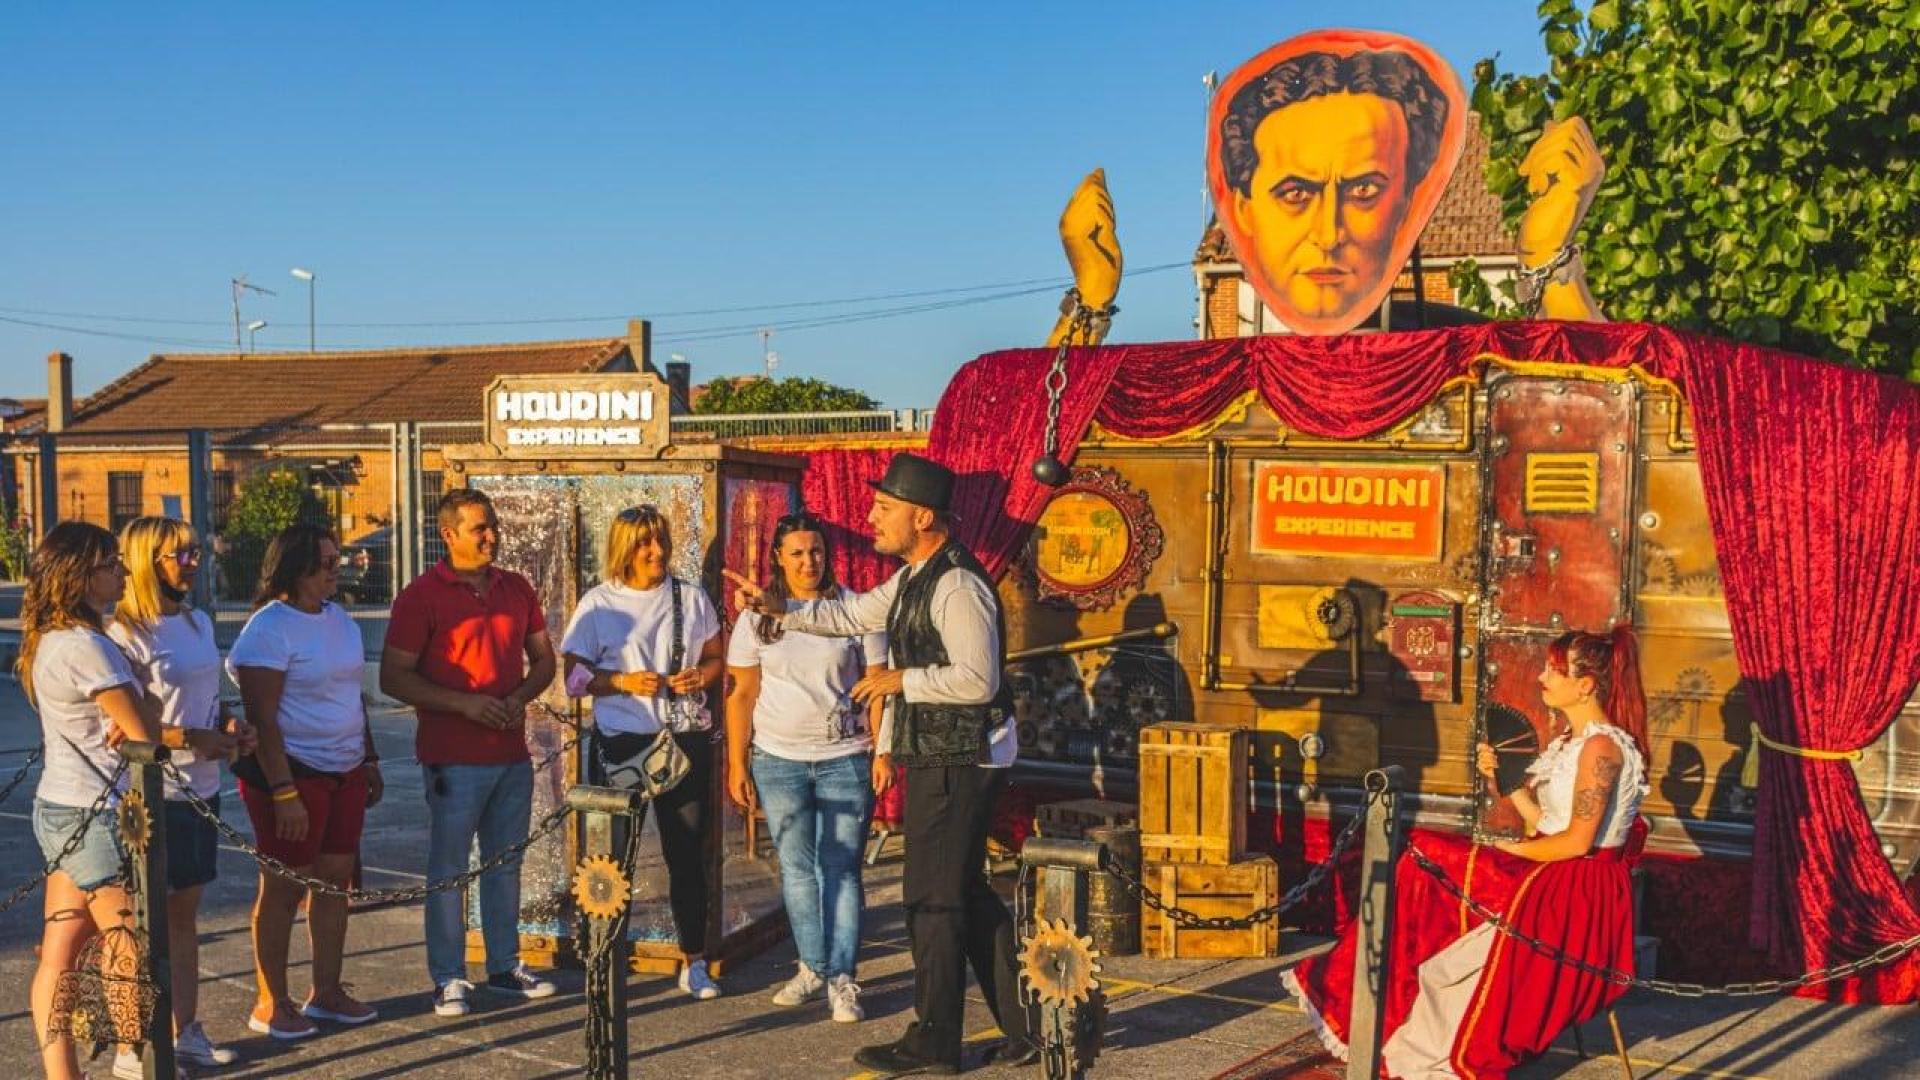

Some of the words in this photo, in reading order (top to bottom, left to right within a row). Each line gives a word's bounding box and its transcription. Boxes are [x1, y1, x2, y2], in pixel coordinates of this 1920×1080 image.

[497, 390, 653, 421] HOUDINI
[507, 427, 642, 445] EXPERIENCE
[1267, 475, 1431, 507] HOUDINI
[1275, 516, 1417, 540] EXPERIENCE
